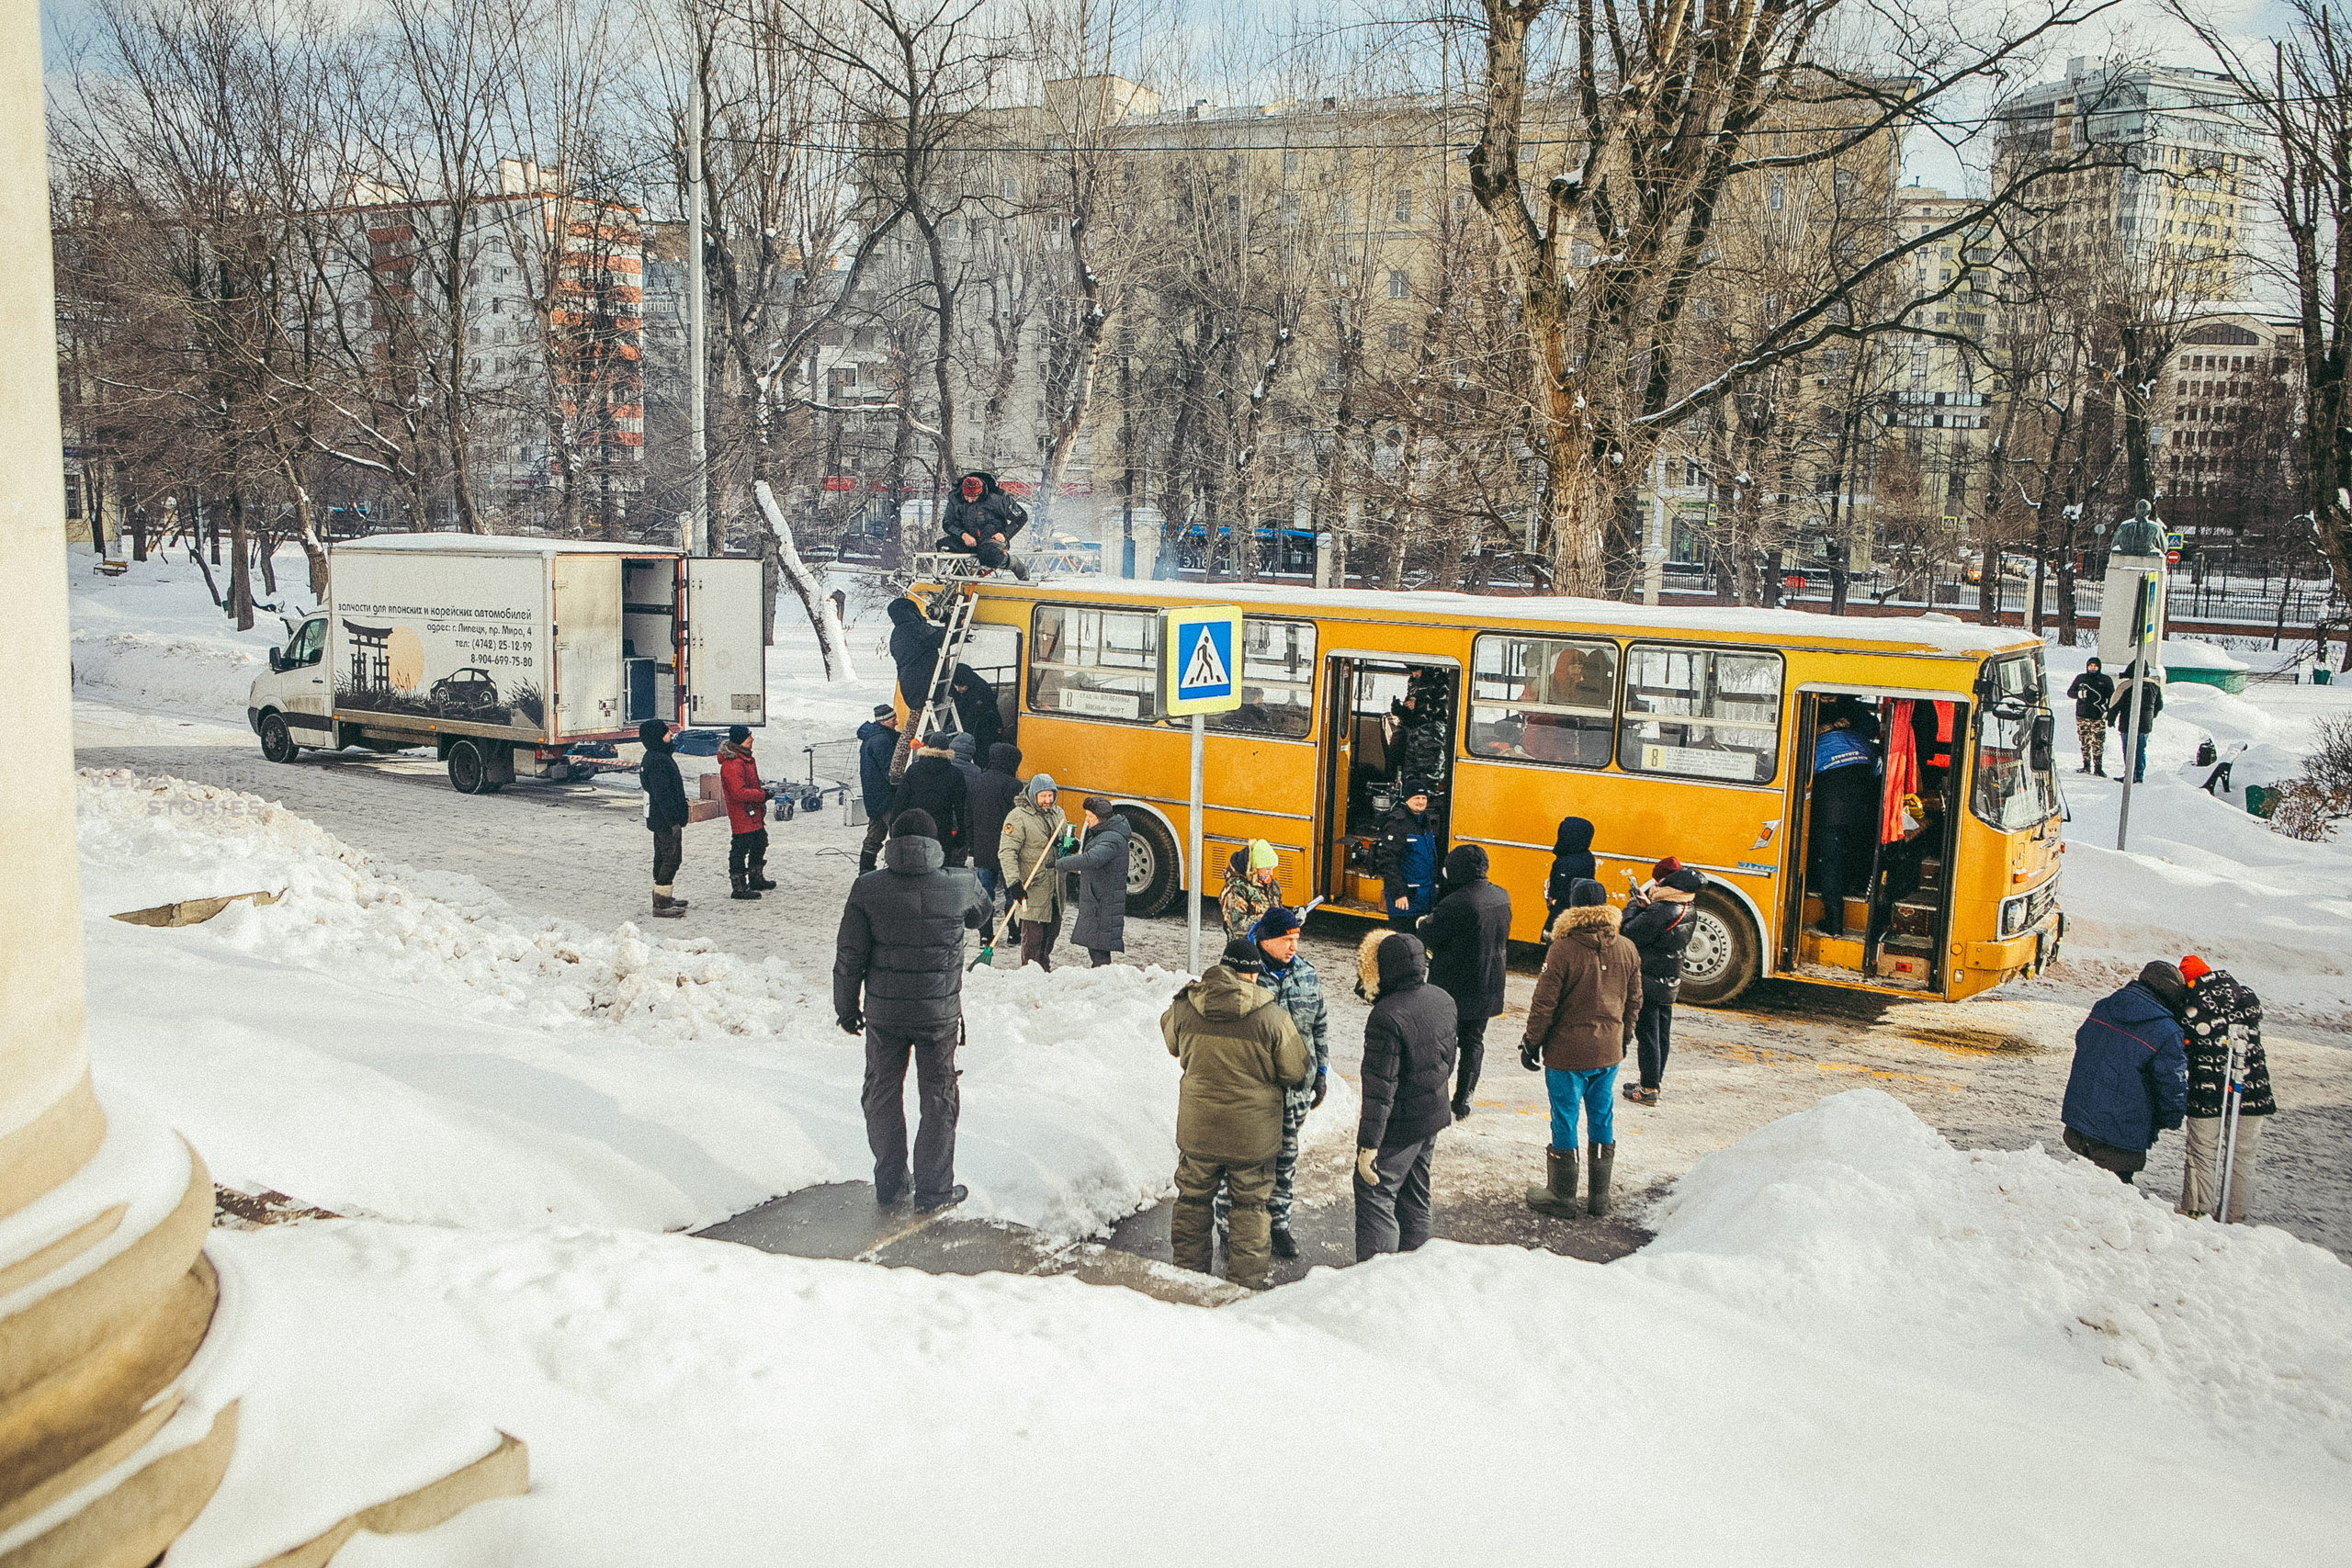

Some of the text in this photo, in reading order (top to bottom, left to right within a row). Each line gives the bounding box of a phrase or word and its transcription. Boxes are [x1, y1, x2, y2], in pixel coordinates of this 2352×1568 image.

[338, 604, 532, 620] запчасти для японских и корейских автомобилей
[427, 624, 451, 633] адрес:
[458, 623, 488, 636] Липецк,
[489, 626, 501, 637] пр.
[502, 625, 526, 637] Мира,
[526, 626, 532, 636] 4
[455, 638, 533, 651] тел: (4742) 25-12-99
[470, 654, 533, 667] 8-904-699-75-80
[1651, 749, 1658, 767] 8
